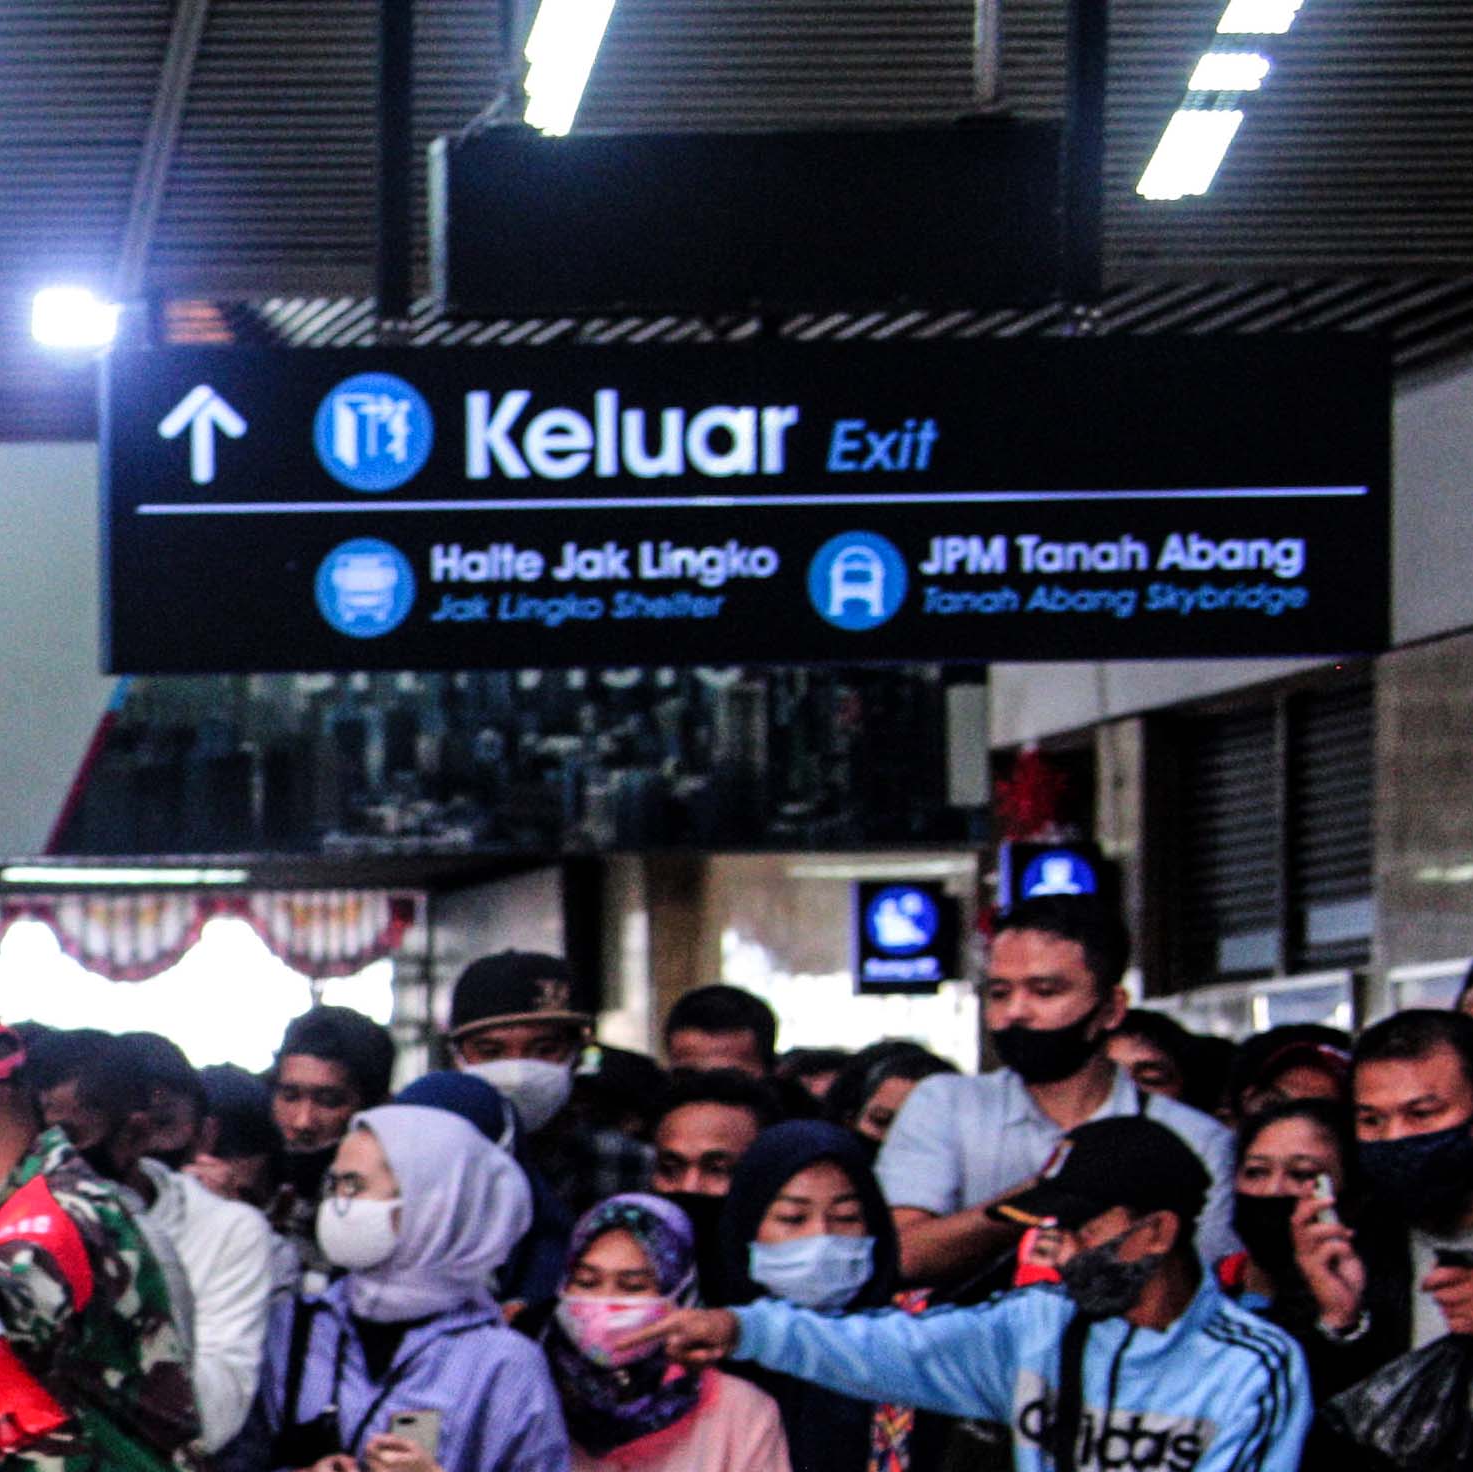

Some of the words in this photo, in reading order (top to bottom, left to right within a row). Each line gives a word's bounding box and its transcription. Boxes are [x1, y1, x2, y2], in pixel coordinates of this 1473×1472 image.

[464, 388, 799, 479] Keluar
[825, 418, 939, 473] Exit
[429, 542, 545, 582] Halte
[551, 541, 631, 581] Jak
[638, 539, 780, 587] Lingko
[919, 534, 1008, 575] JPM
[1015, 533, 1149, 573] Tanah
[1156, 531, 1306, 578] Abang
[431, 593, 489, 622] Jak
[923, 586, 1019, 613] Tanah
[1025, 584, 1138, 618] Abang
[1145, 582, 1309, 615] Skybridge
